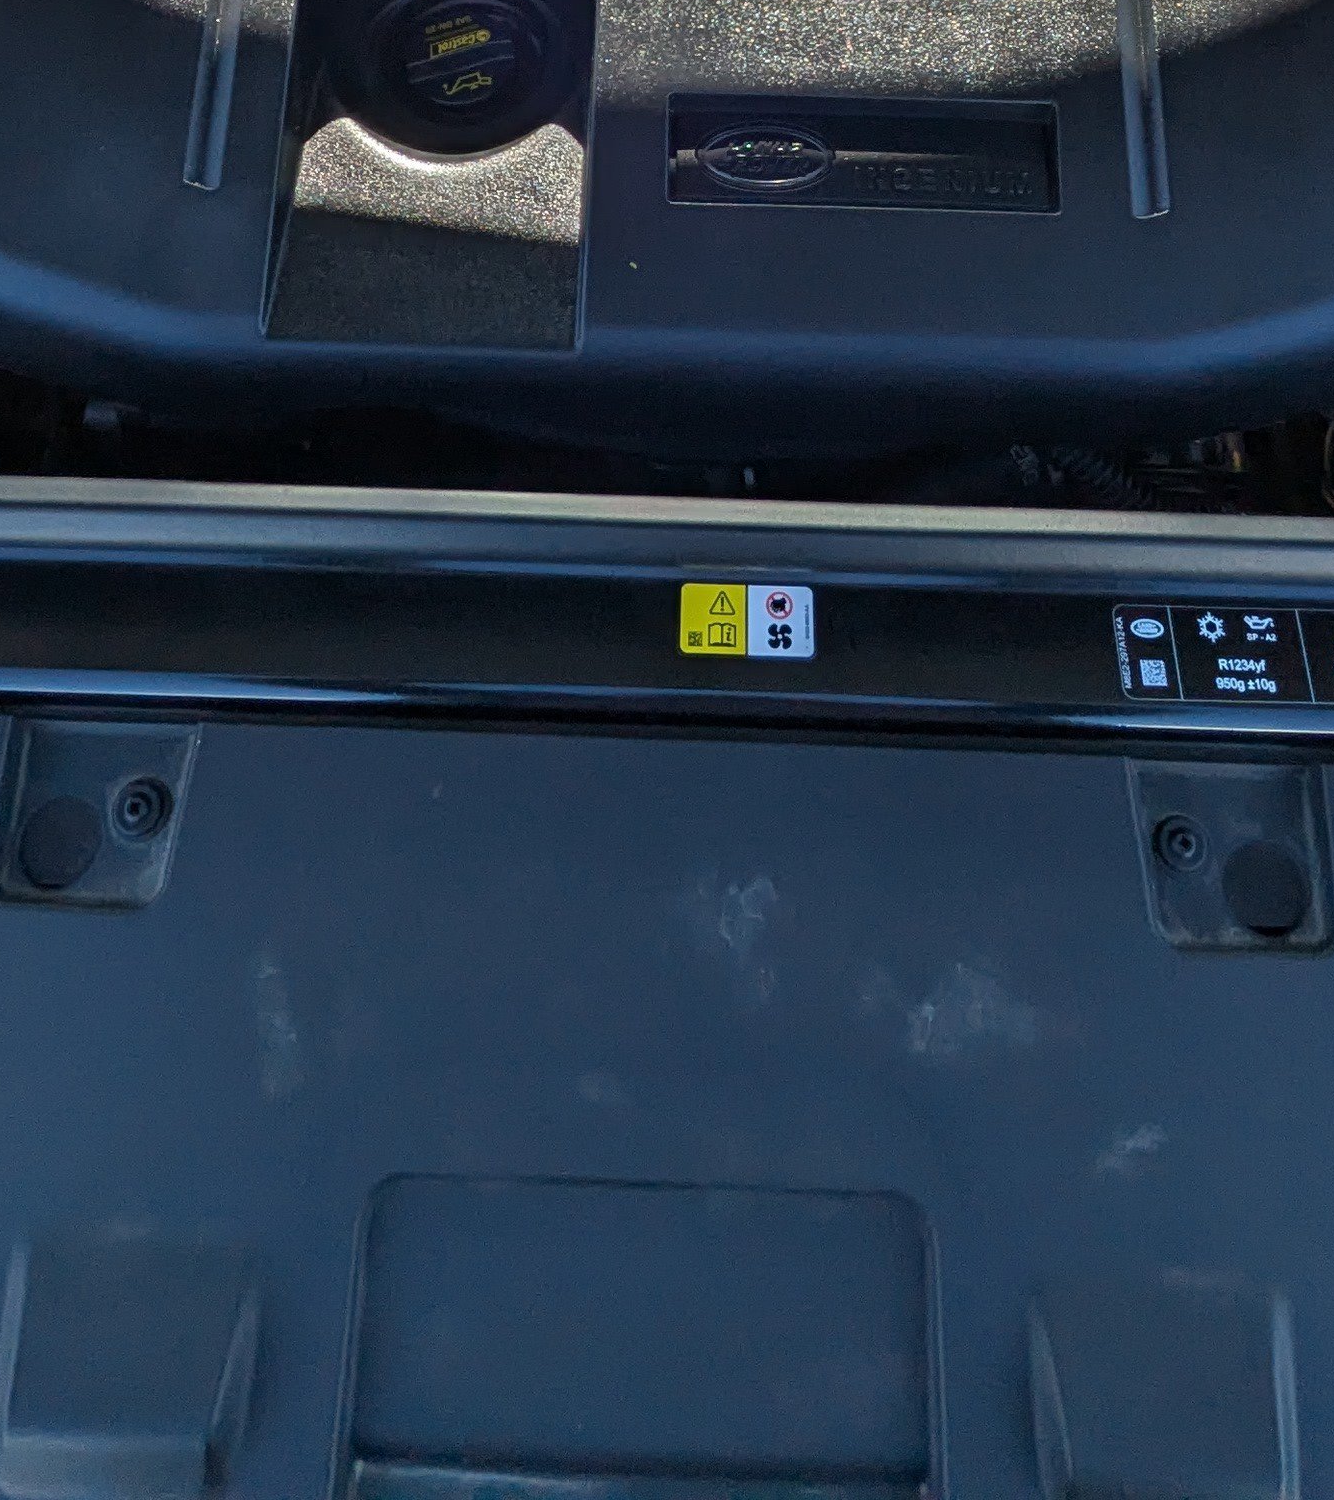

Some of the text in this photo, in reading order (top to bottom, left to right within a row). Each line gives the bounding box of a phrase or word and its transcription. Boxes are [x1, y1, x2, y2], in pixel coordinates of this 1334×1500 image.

[438, 34, 476, 54] Castrol
[1265, 633, 1278, 642] A2
[1218, 658, 1266, 674] R1234yf
[1215, 677, 1277, 693] 950g ±10g
